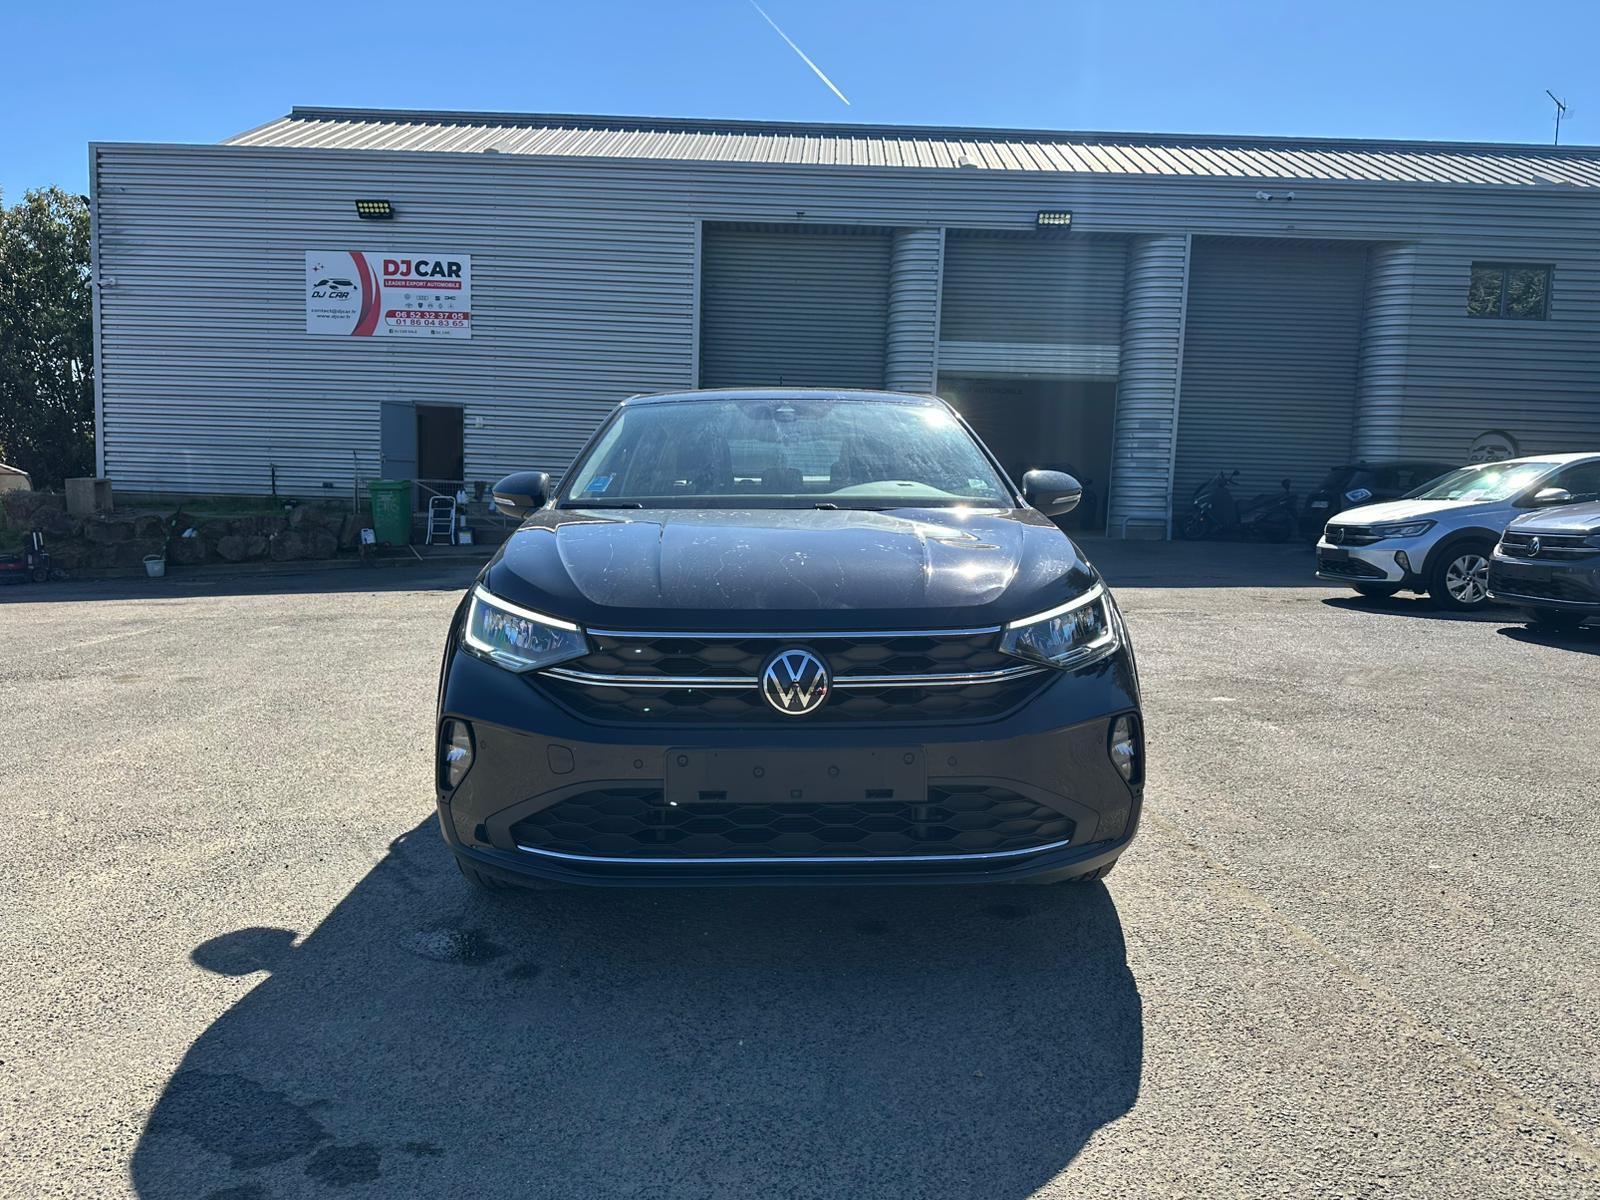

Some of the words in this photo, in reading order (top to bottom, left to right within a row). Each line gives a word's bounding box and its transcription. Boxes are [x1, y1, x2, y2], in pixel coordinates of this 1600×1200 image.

[383, 259, 411, 276] DJ
[414, 260, 462, 277] CAR
[424, 319, 436, 327] 04
